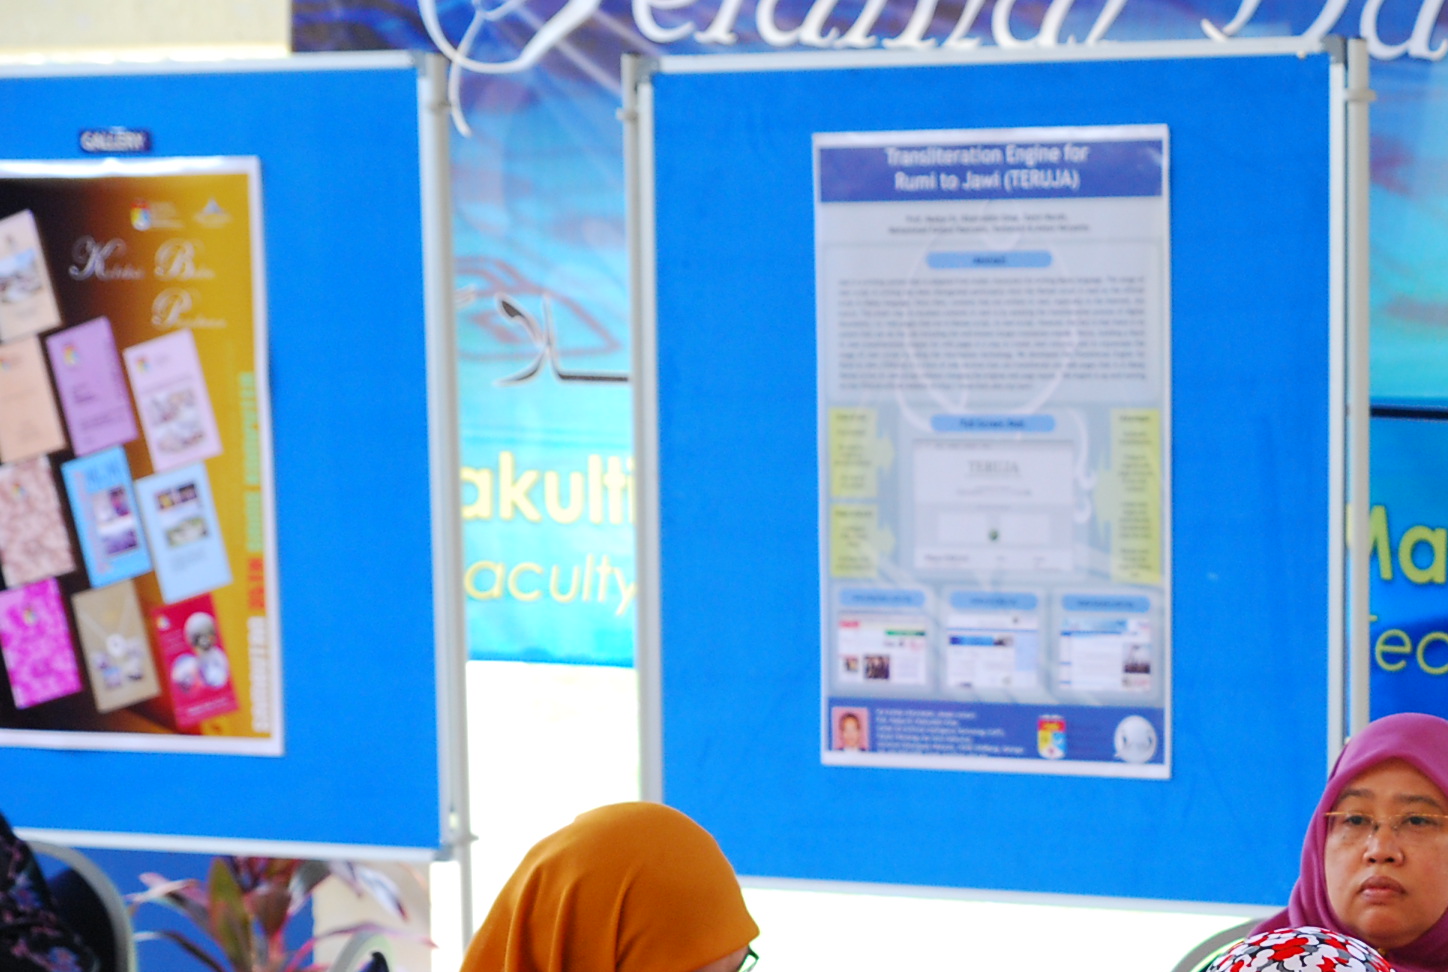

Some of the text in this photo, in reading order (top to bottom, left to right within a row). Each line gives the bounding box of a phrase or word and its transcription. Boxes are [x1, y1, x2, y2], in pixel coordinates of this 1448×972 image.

[884, 142, 1089, 167] Transliteration Engine for
[894, 168, 1081, 193] Rumi to Jawi (TERUJA)
[464, 553, 638, 616] aculty
